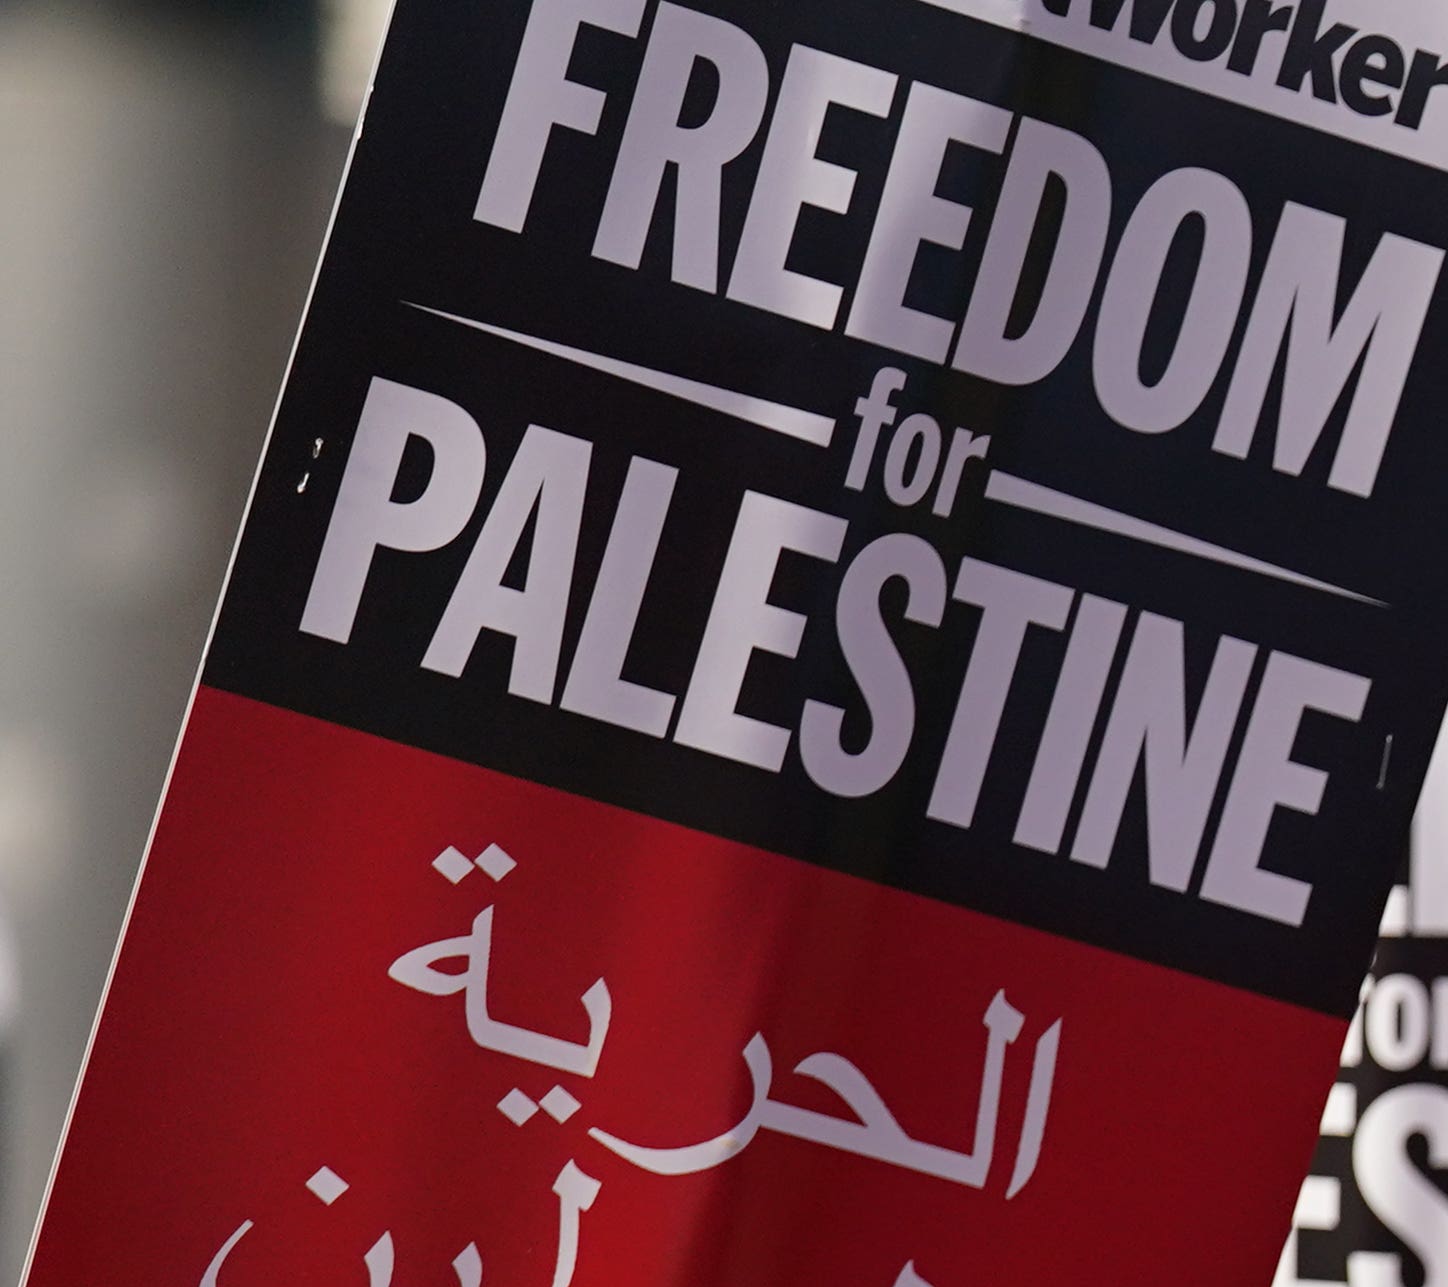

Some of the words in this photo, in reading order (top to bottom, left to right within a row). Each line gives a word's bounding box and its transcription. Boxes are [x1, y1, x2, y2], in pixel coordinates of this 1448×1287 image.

[474, 0, 1445, 499] FREEDOM
[844, 368, 990, 518] for
[299, 376, 1373, 928] PALESTINE
[388, 843, 1063, 1200] الحرية
